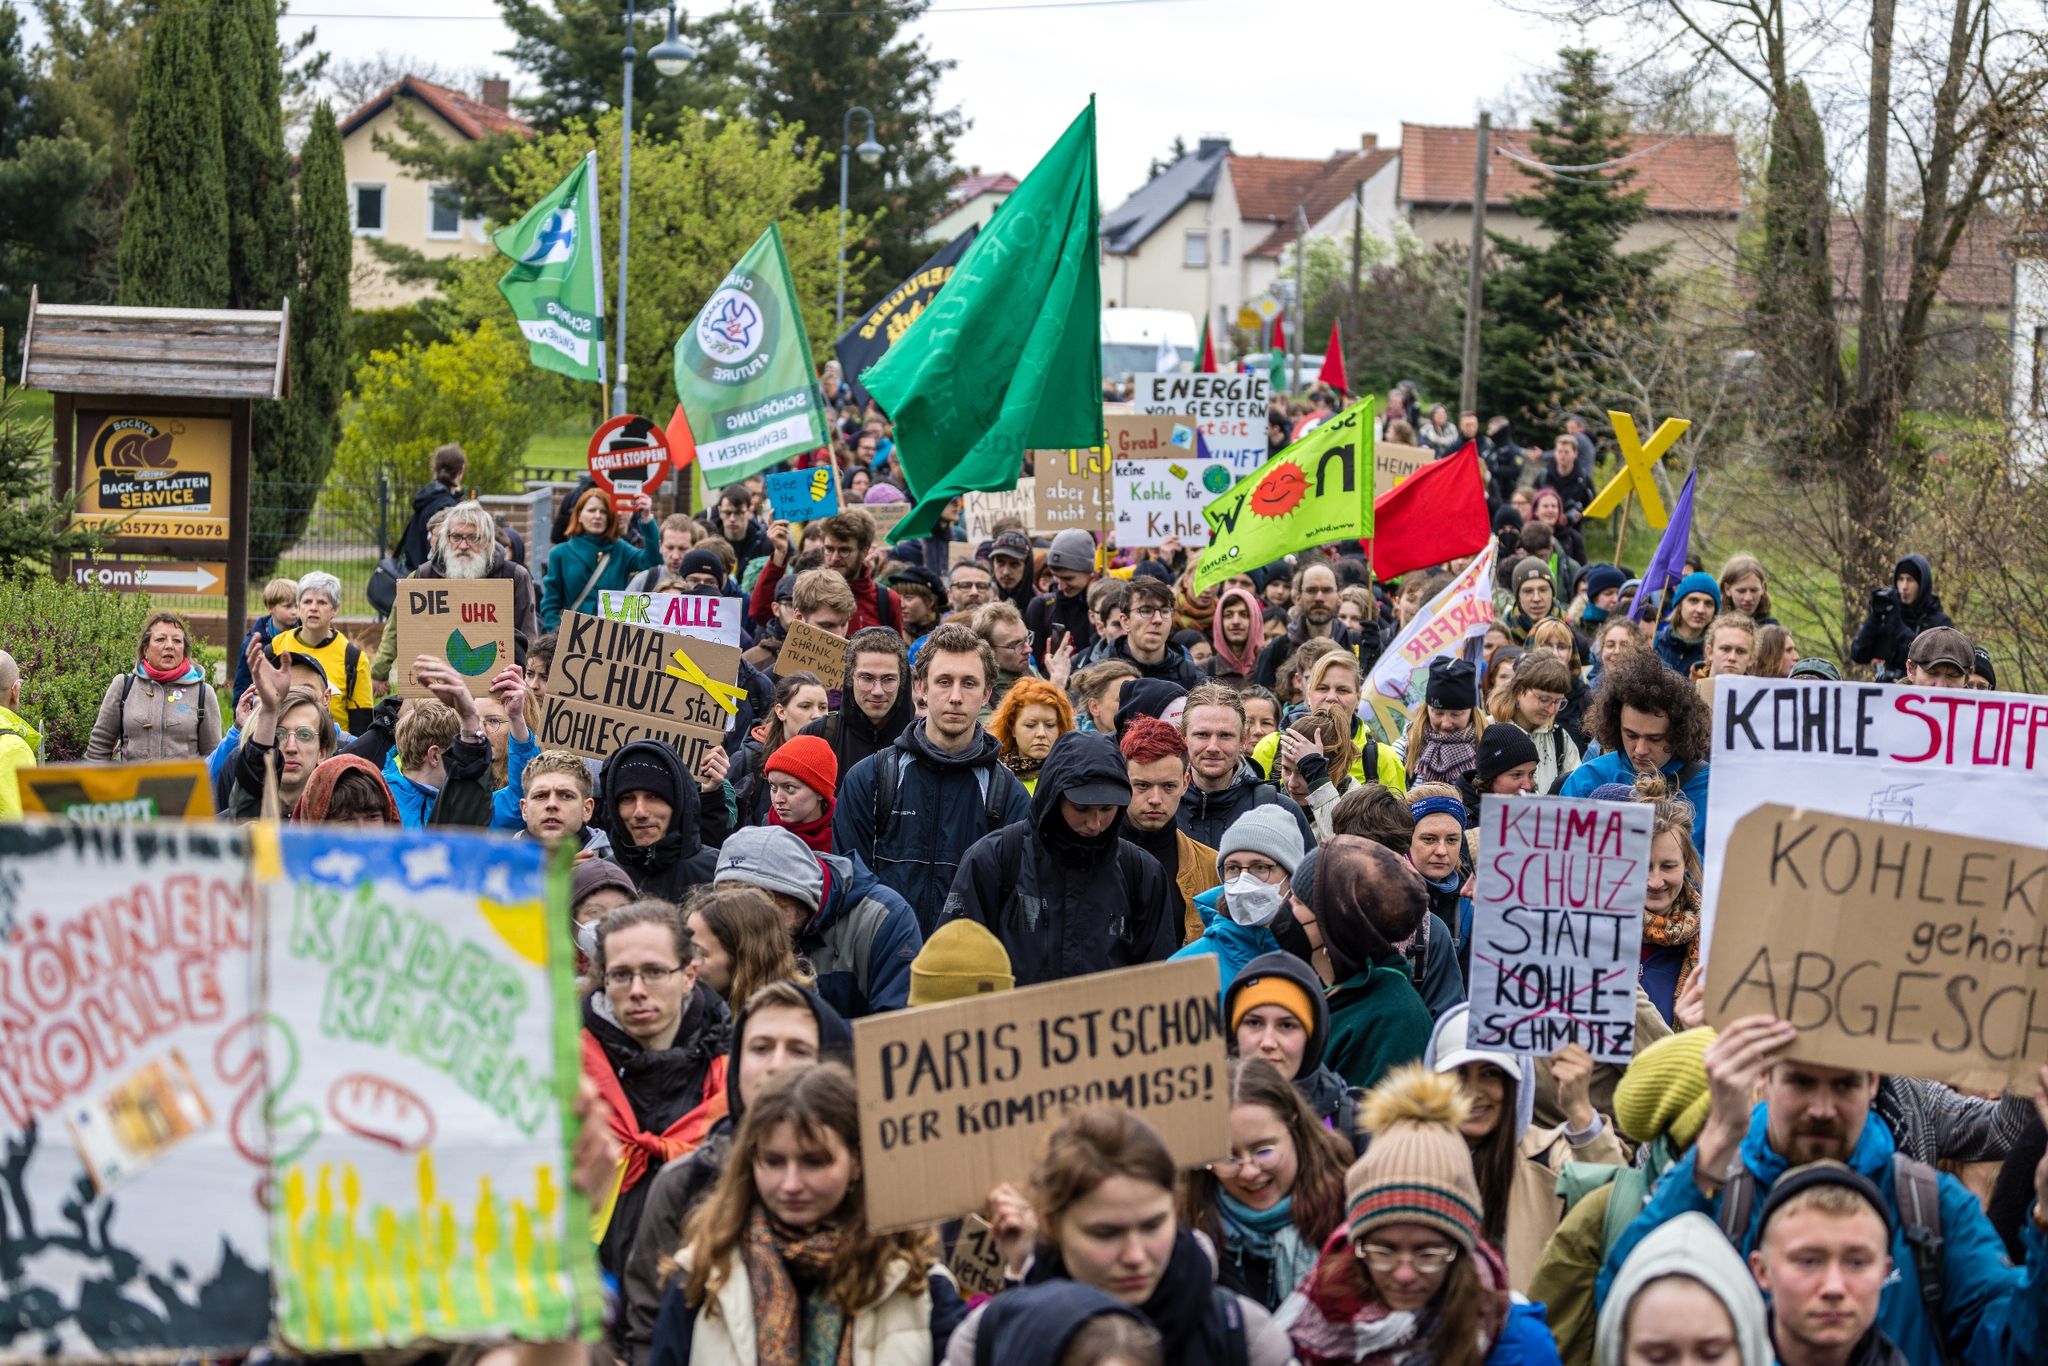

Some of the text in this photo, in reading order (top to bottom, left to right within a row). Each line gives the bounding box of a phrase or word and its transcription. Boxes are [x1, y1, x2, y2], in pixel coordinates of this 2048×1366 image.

[1186, 401, 1268, 418] GESTERN
[591, 447, 667, 471] KOHLE STOPPEN!
[1115, 461, 1145, 477] keine
[102, 482, 139, 495] BACK-
[156, 477, 209, 491] PLATTEN
[772, 478, 797, 491] Bee
[1046, 479, 1084, 501] aber
[1131, 480, 1202, 501] Kohle für
[120, 489, 194, 508] SERVICE
[1047, 504, 1086, 521] nicht
[174, 524, 223, 537] 70878
[409, 590, 450, 615] DIE
[461, 602, 498, 623] UHR
[602, 592, 722, 628] WIR ALLE
[788, 649, 816, 666] THAT
[559, 653, 681, 715] SCHUTZ
[1725, 686, 1883, 756] KOHLE
[66, 797, 155, 822] STOPPT
[1500, 804, 1646, 857] KLIMA-
[1770, 821, 2048, 917] KOHLEK
[1483, 851, 1638, 913] SCHUTZ
[1487, 905, 1637, 962] STATT
[1906, 917, 2048, 967] gehört
[289, 879, 529, 1044] KINDER
[1495, 957, 1630, 1015] KOHLE-
[880, 990, 1225, 1101] PARIS IST SCHON
[1476, 1014, 1635, 1056] SCHMUTZ
[879, 1063, 1214, 1152] DER KOMPROMISS!
